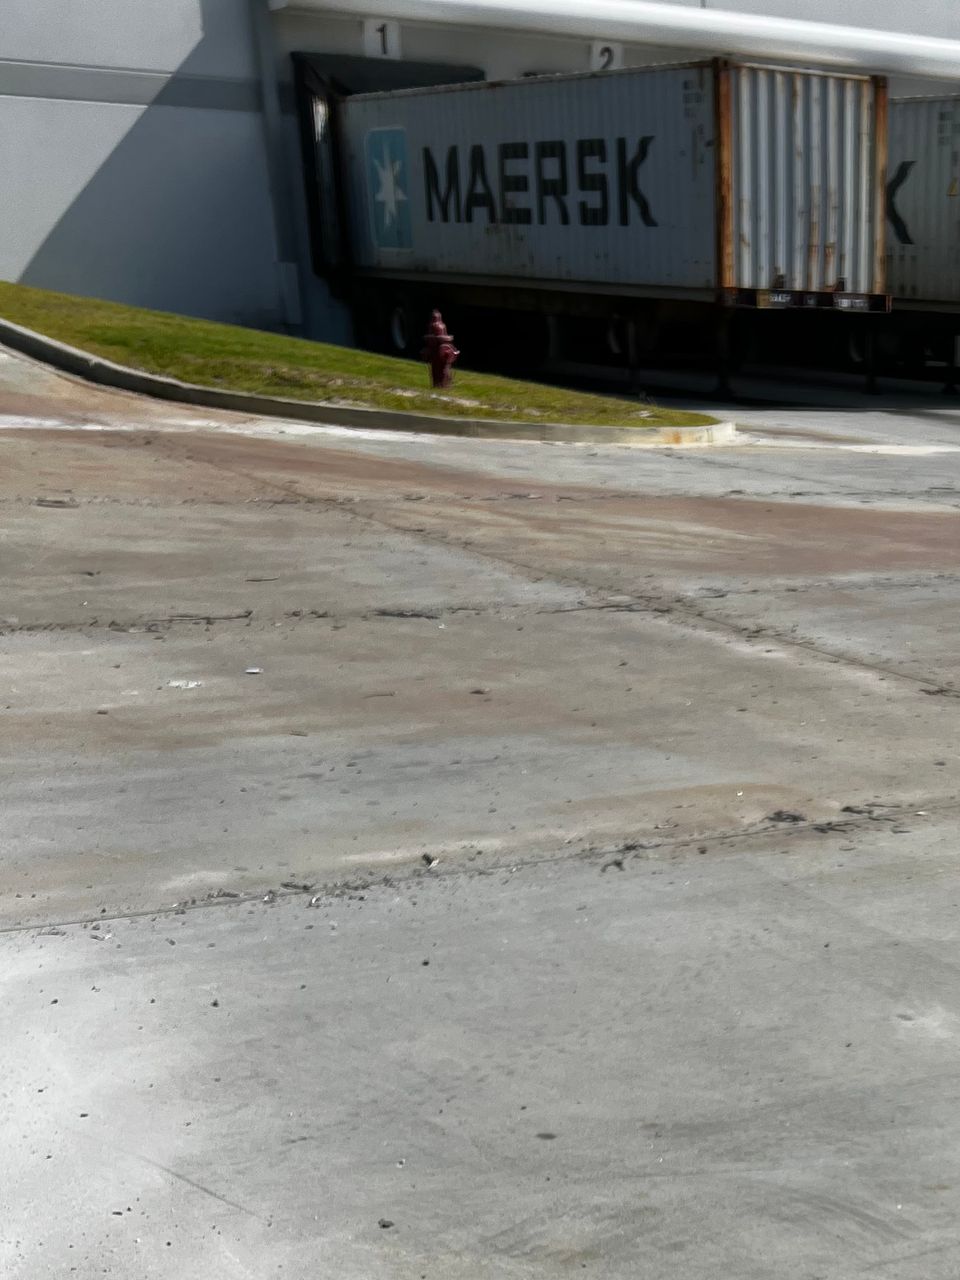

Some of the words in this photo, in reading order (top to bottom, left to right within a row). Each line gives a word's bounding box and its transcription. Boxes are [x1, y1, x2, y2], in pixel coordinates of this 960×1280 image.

[374, 23, 388, 56] 1
[600, 46, 615, 70] 2
[422, 135, 659, 227] MAERSK
